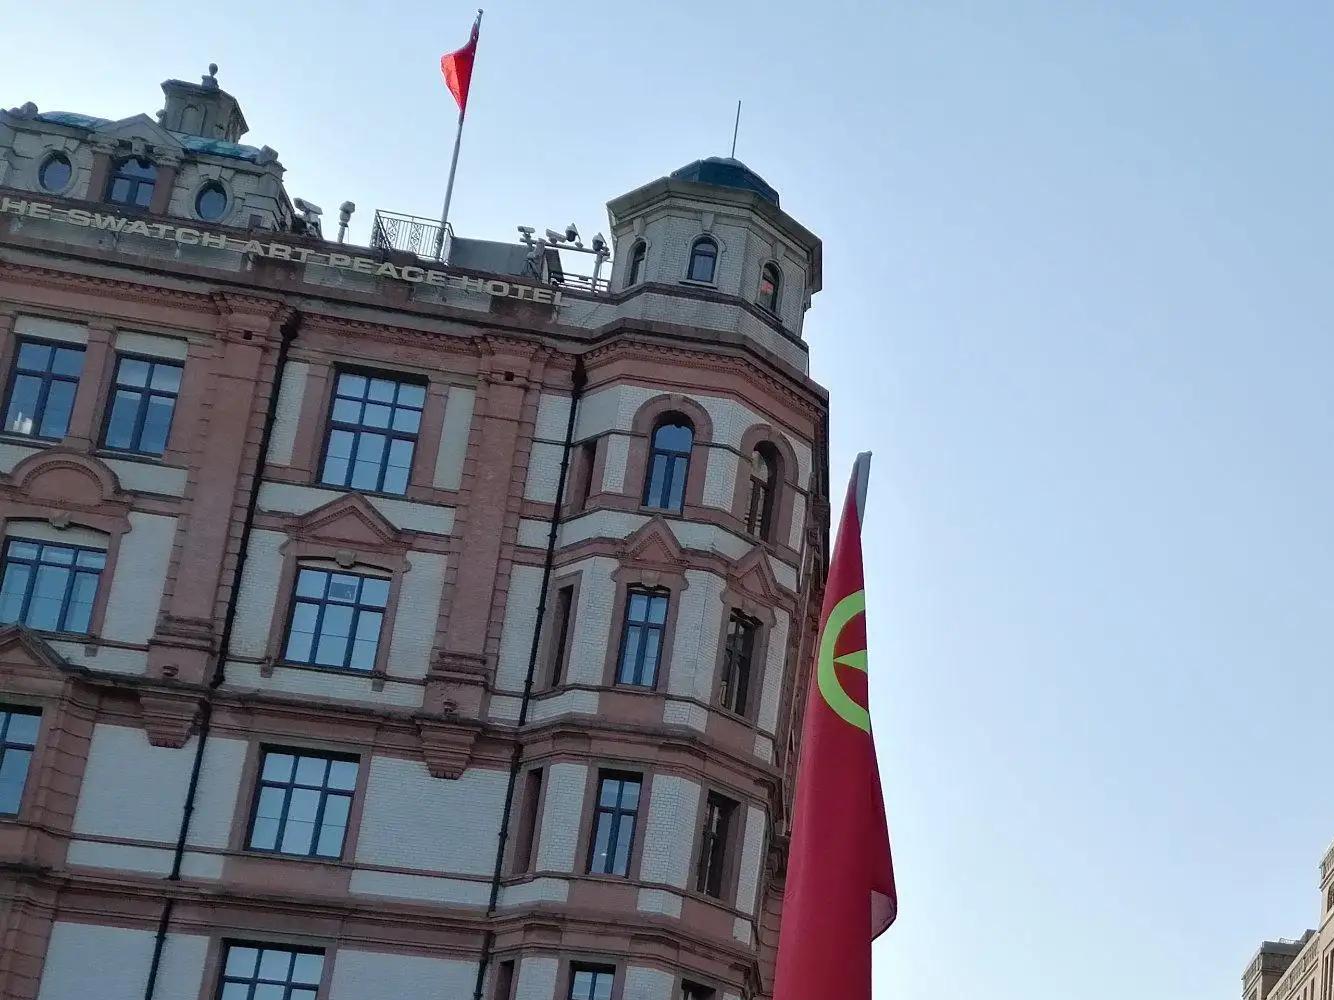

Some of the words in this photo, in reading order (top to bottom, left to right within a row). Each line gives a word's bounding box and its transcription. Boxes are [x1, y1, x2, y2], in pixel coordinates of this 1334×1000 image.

[67, 208, 226, 249] SWATCH
[247, 240, 316, 265] ART
[328, 253, 448, 287] PEACE
[463, 275, 571, 307] HOTEL
